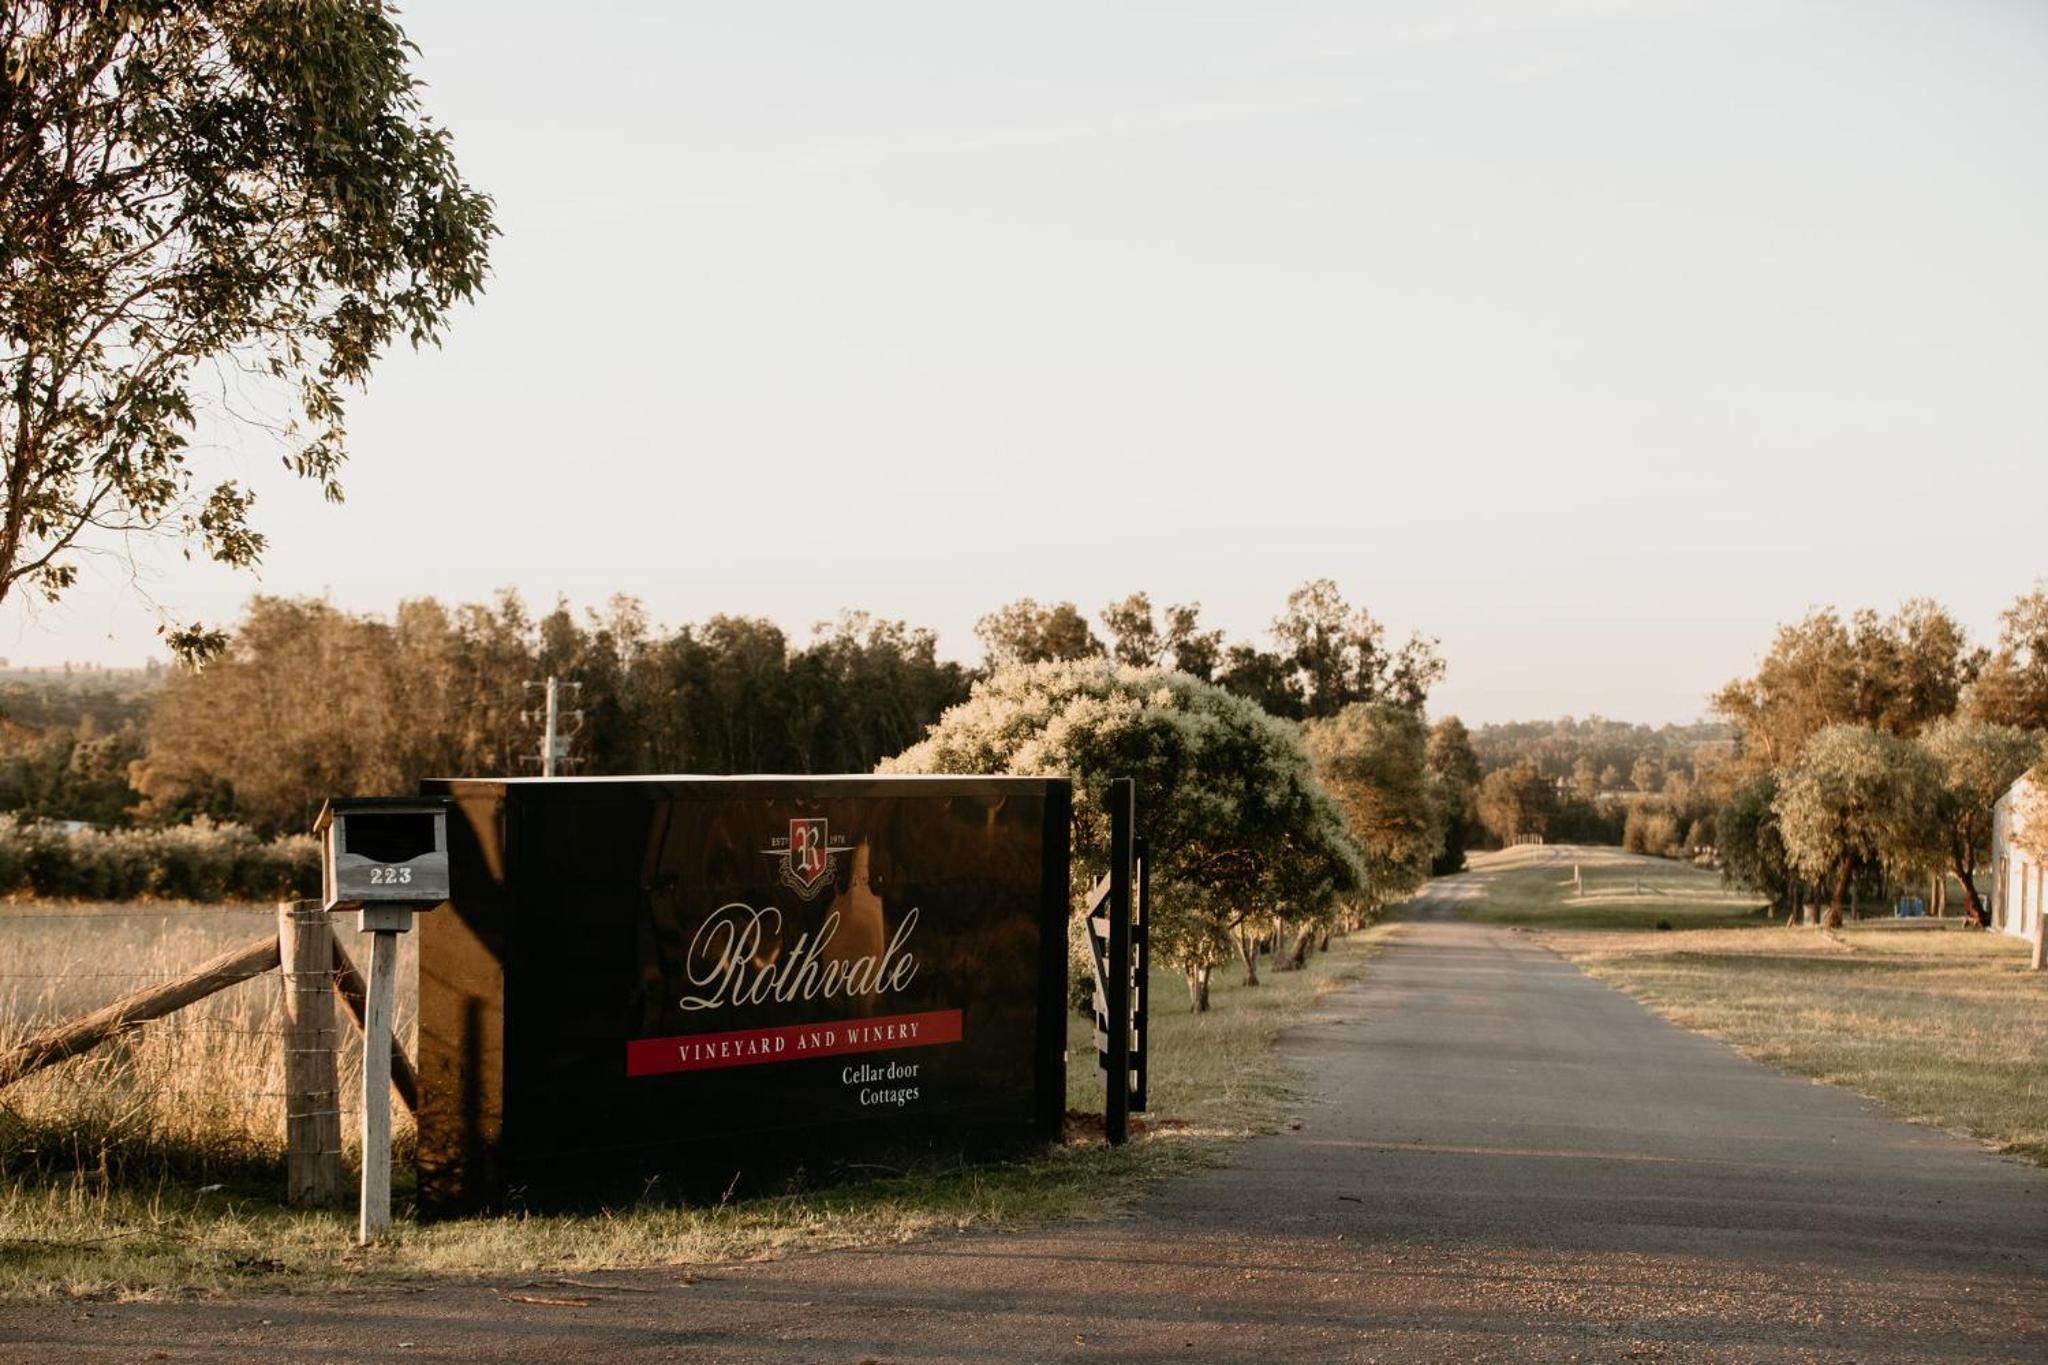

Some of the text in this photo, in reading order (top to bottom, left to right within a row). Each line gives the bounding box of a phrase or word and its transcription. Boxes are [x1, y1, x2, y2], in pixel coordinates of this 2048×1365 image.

[796, 826, 821, 871] R
[370, 868, 412, 884] 223
[679, 902, 920, 1011] Rothvale
[679, 1022, 921, 1062] VINEYARD AND WINERY
[842, 1062, 919, 1085] Cellar door
[860, 1085, 920, 1107] Cottages
